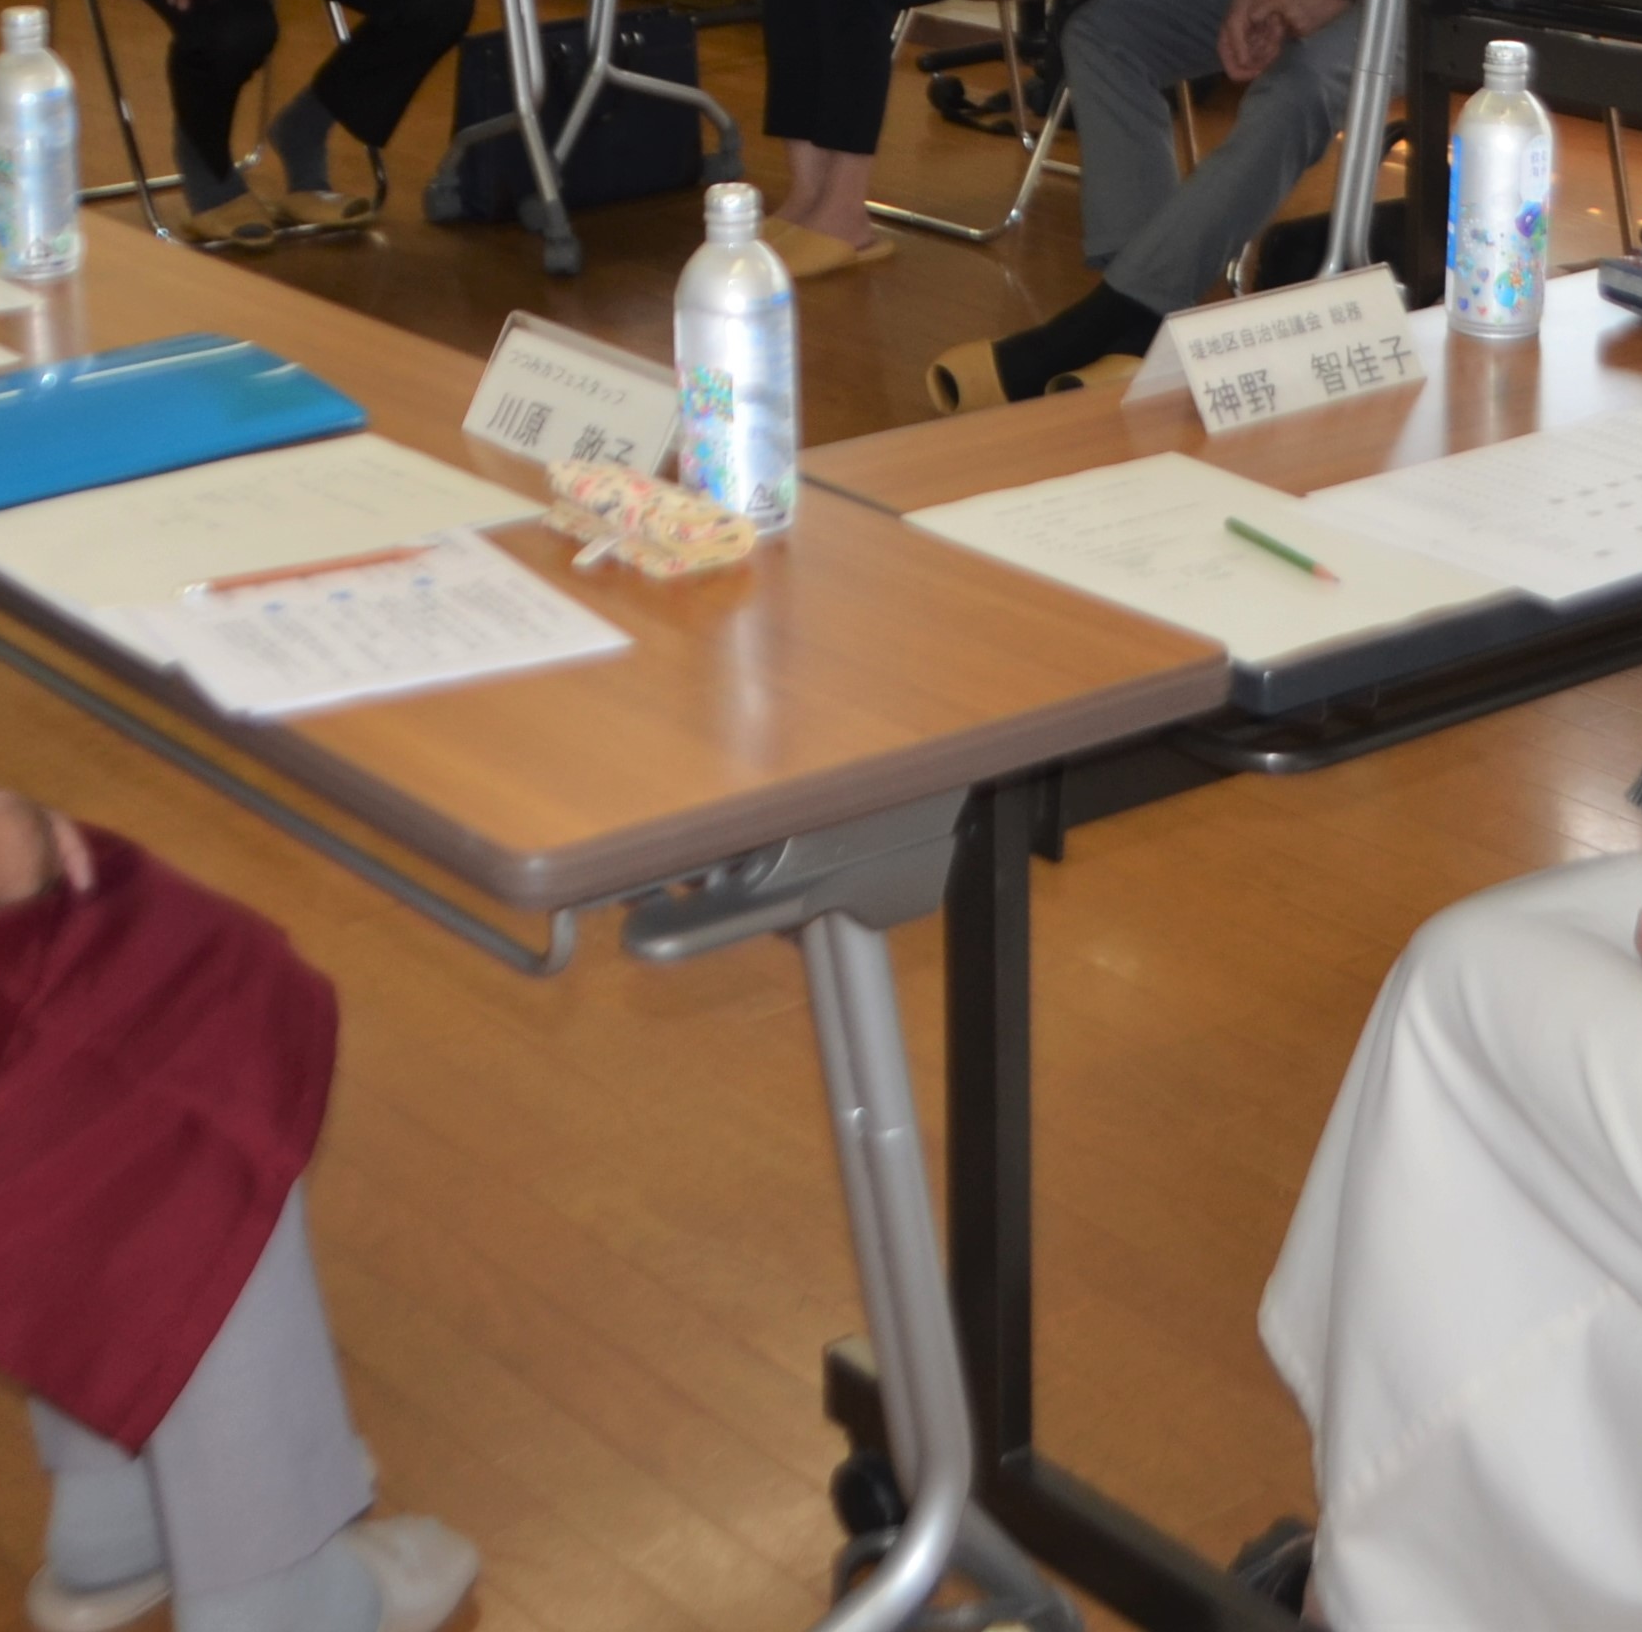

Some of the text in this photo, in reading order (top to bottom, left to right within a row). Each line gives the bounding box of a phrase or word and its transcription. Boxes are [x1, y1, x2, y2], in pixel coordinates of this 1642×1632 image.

[1189, 310, 1324, 361] 堤地区自治協議会
[1203, 334, 1412, 425] 神野 智佳子
[487, 390, 554, 448] 川原
